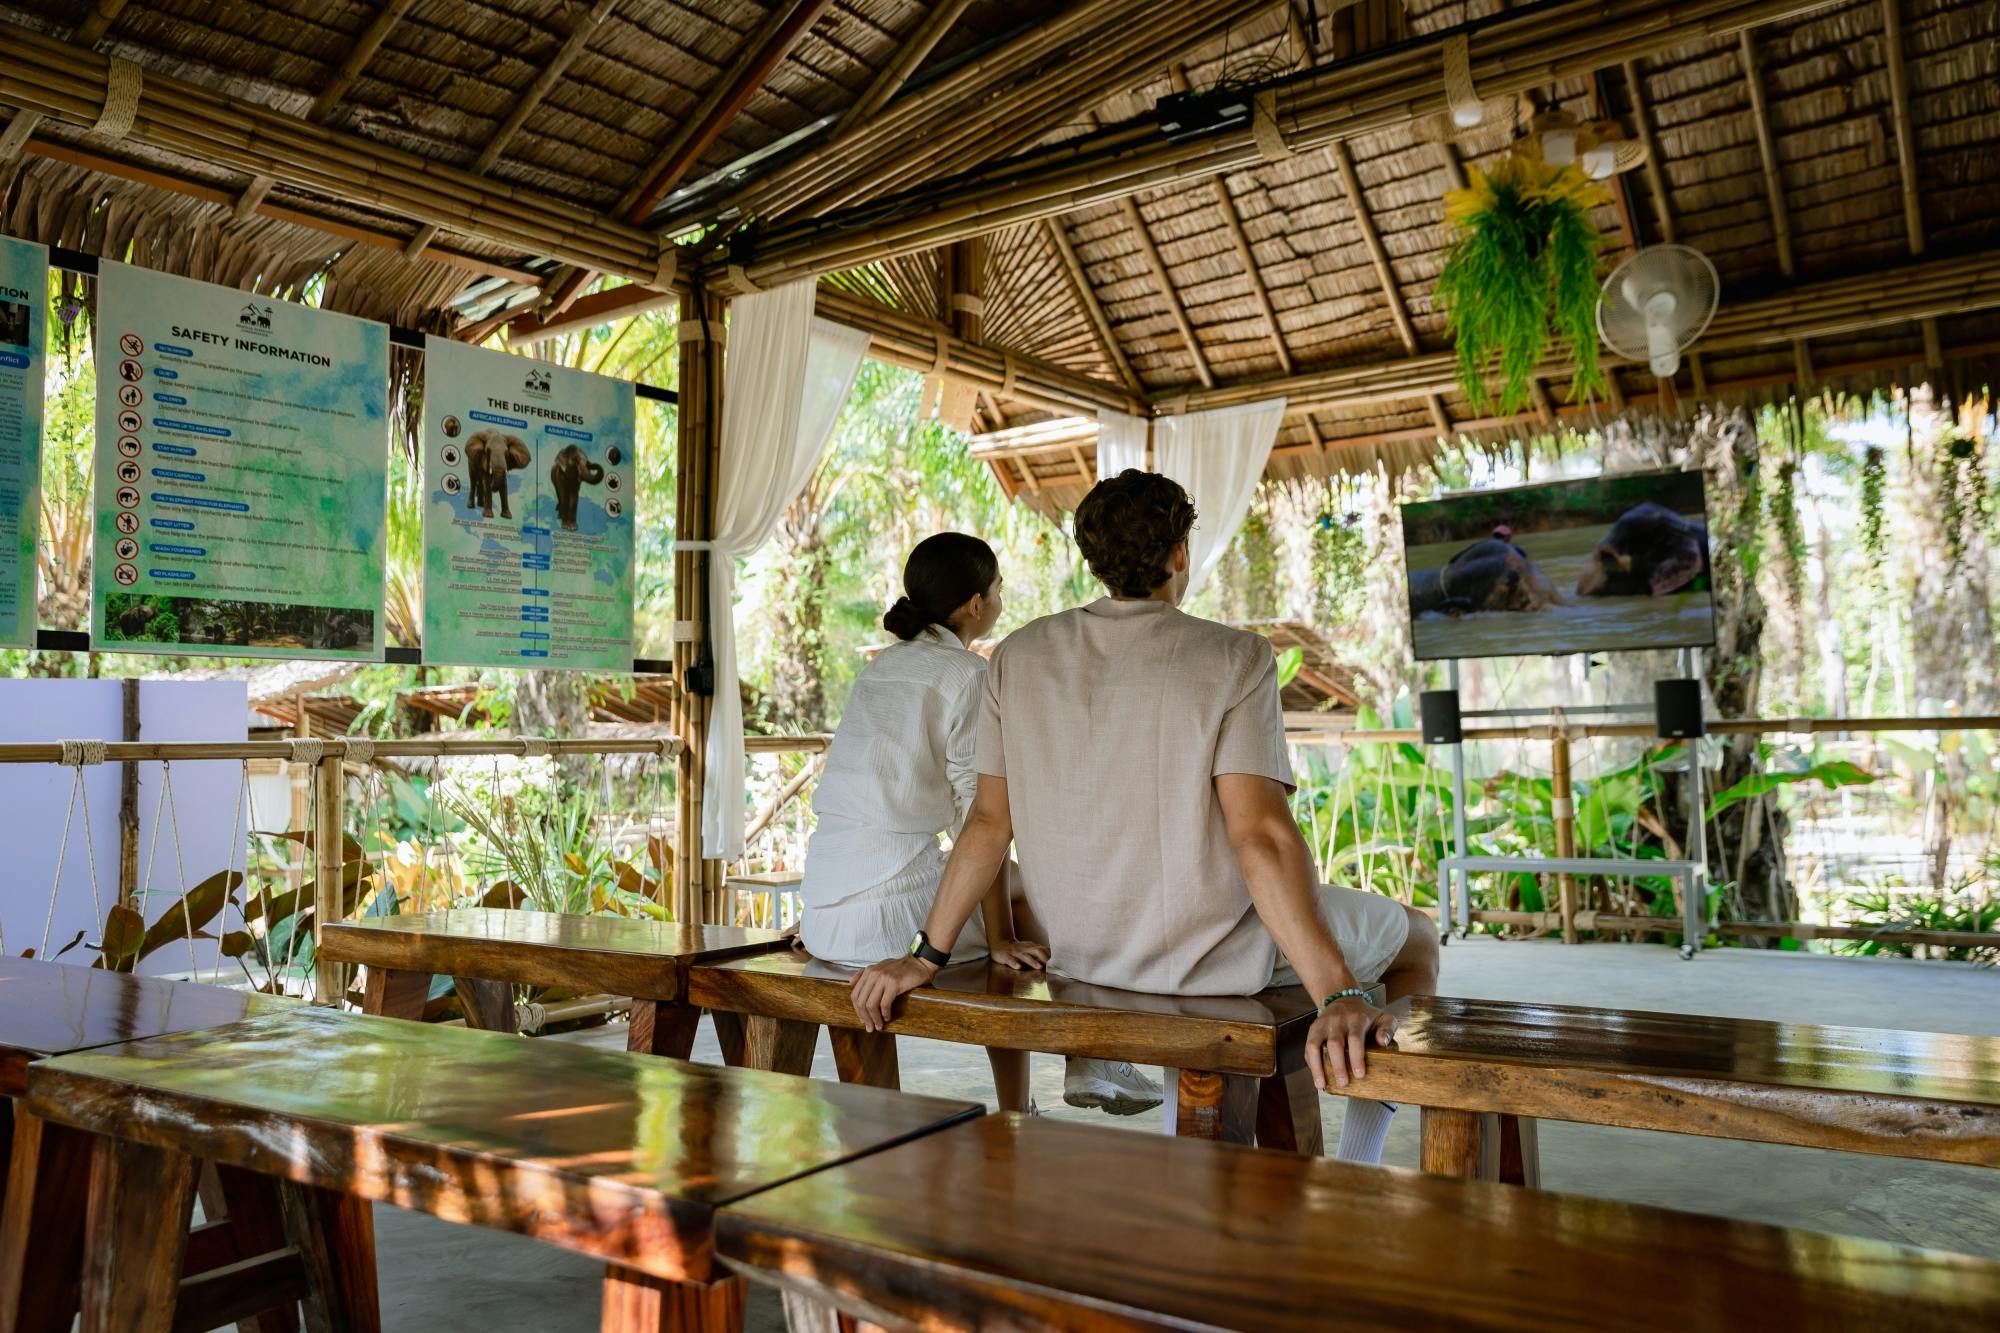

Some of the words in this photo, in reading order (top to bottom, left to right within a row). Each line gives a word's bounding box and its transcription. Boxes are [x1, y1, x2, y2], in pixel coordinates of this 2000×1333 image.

[172, 326, 229, 346] SAFETY
[235, 339, 330, 367] INFORMATION
[487, 397, 509, 411] THE
[513, 403, 584, 425] DIFFERENCES
